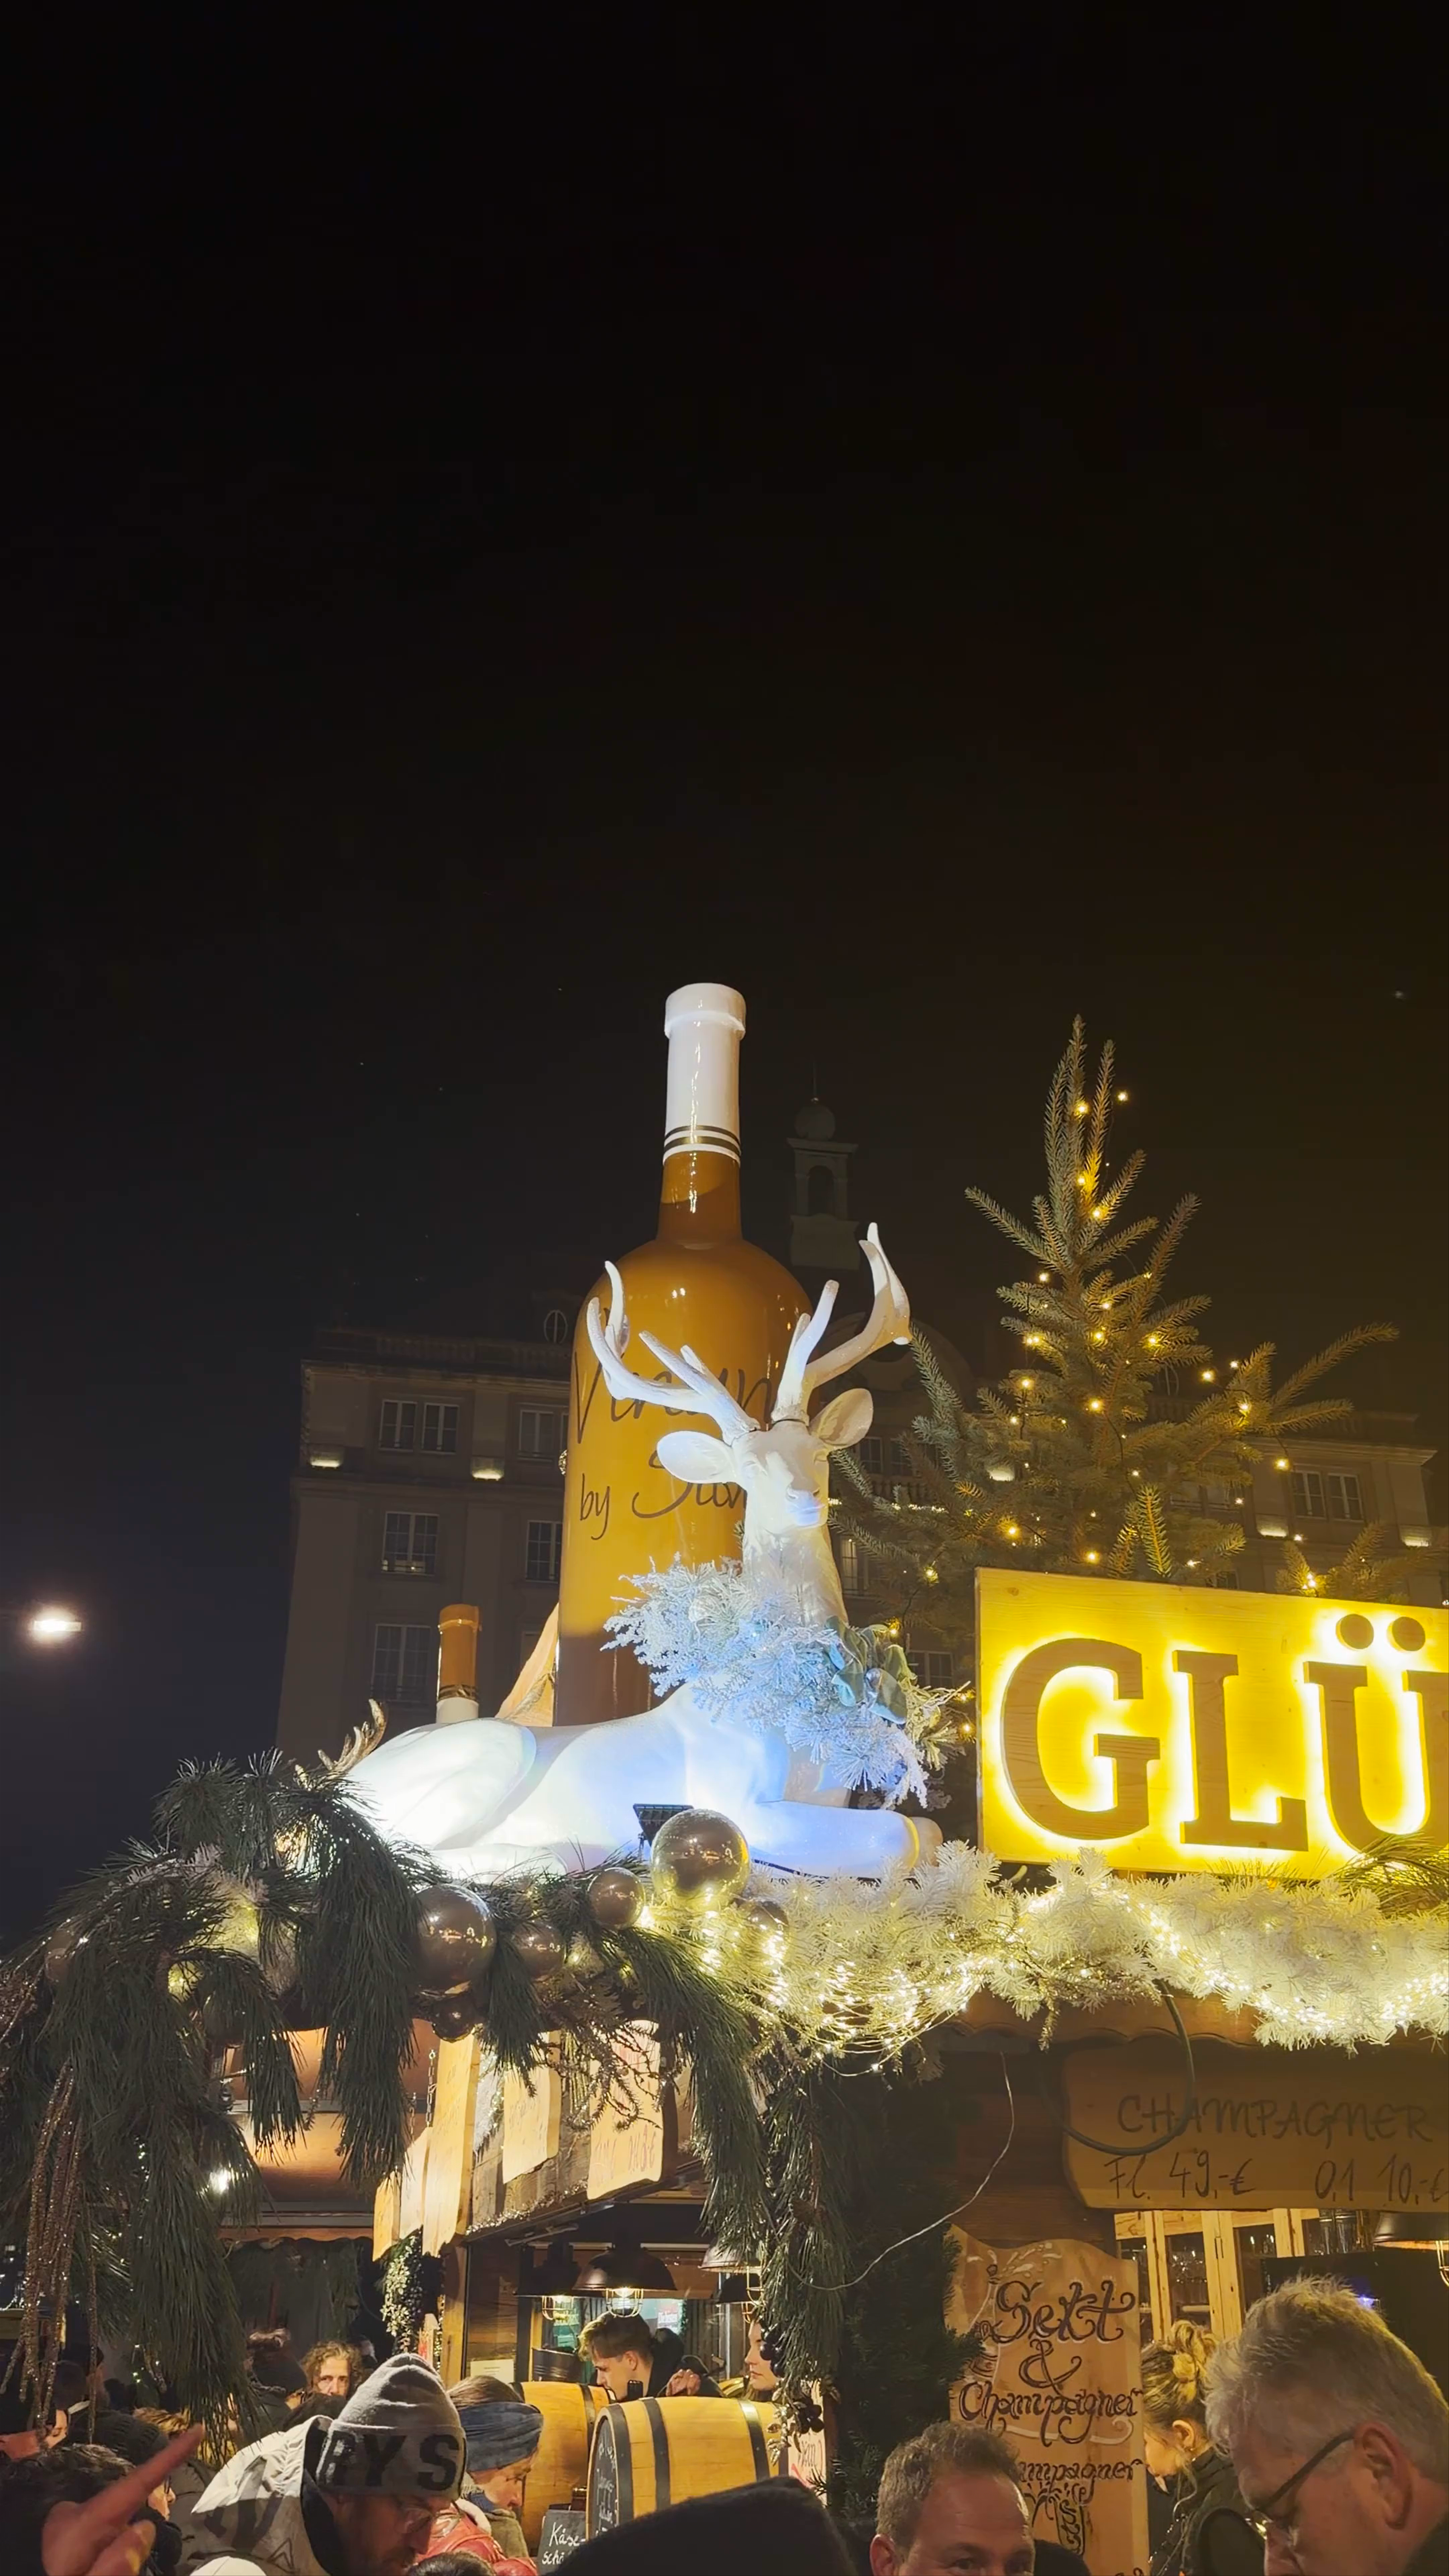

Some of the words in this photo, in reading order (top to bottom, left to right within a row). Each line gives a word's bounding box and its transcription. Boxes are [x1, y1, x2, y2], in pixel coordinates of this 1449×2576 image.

[580, 1473, 610, 1540] by
[1001, 1613, 1449, 1856] GLÜ
[1117, 2093, 1434, 2150] CHAMPAGNER
[1315, 2158, 1354, 2202] 0,1
[981, 2279, 1135, 2343] Sekt
[1018, 2339, 1082, 2397] &
[959, 2381, 1143, 2447] Champagner
